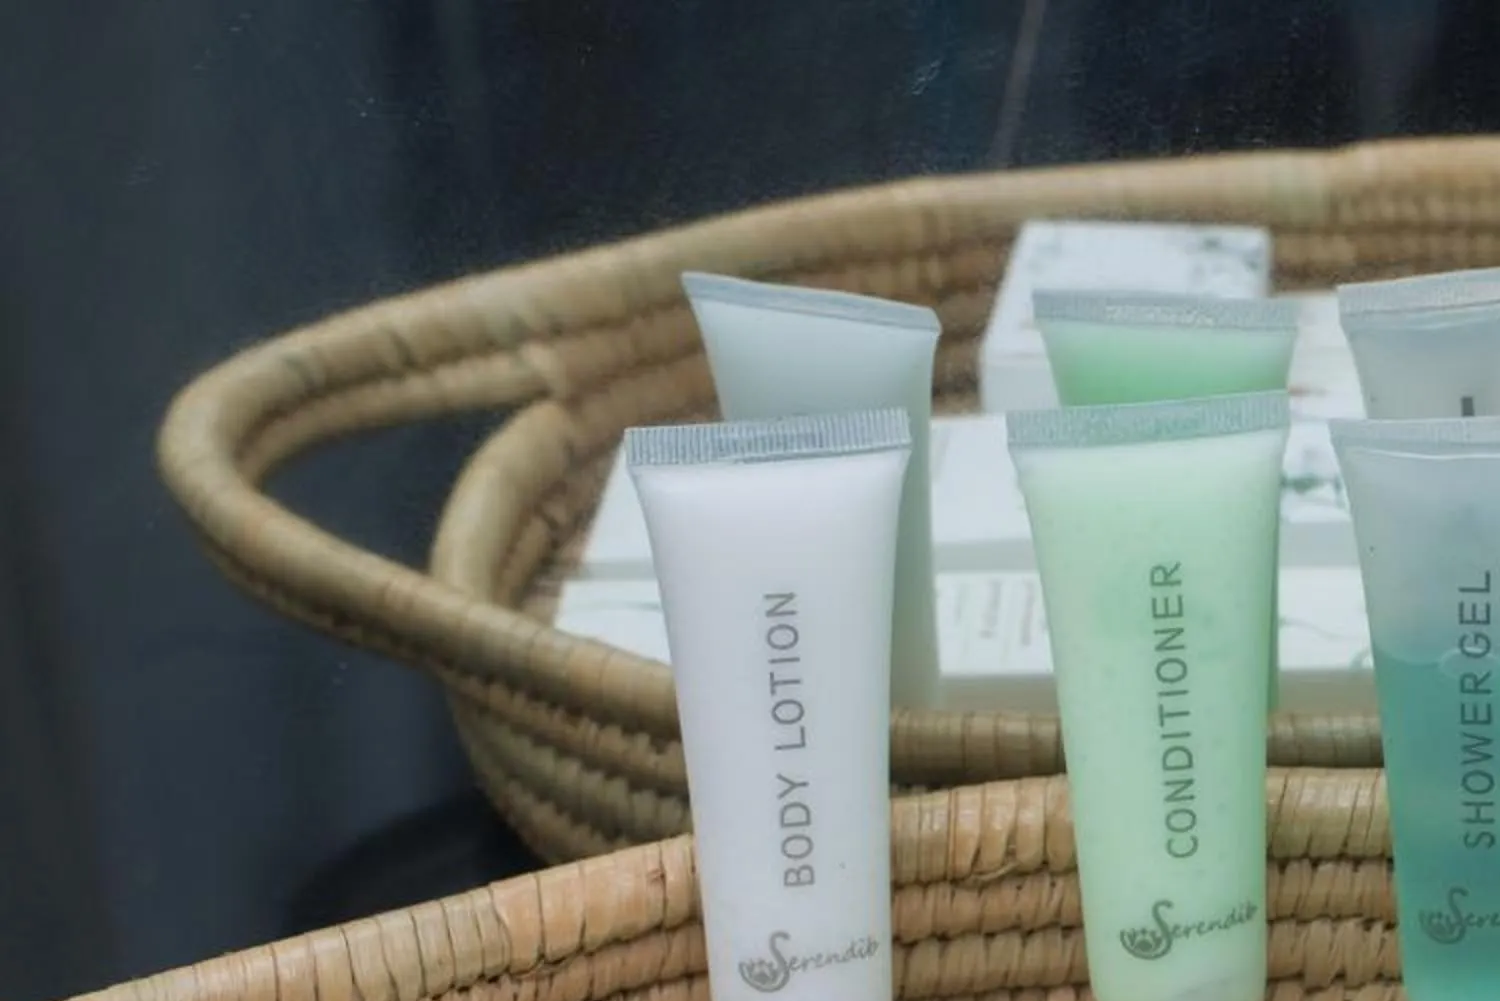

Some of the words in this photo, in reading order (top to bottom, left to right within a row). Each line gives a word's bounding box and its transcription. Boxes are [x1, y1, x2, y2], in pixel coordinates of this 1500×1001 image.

[763, 591, 807, 751] LOTION
[1458, 571, 1491, 660] GEL
[1150, 560, 1199, 860] CONDITIONER
[1460, 669, 1496, 850] SHOWER
[777, 773, 815, 888] BODY
[738, 930, 880, 992] Serendib
[1120, 899, 1259, 961] Serendib
